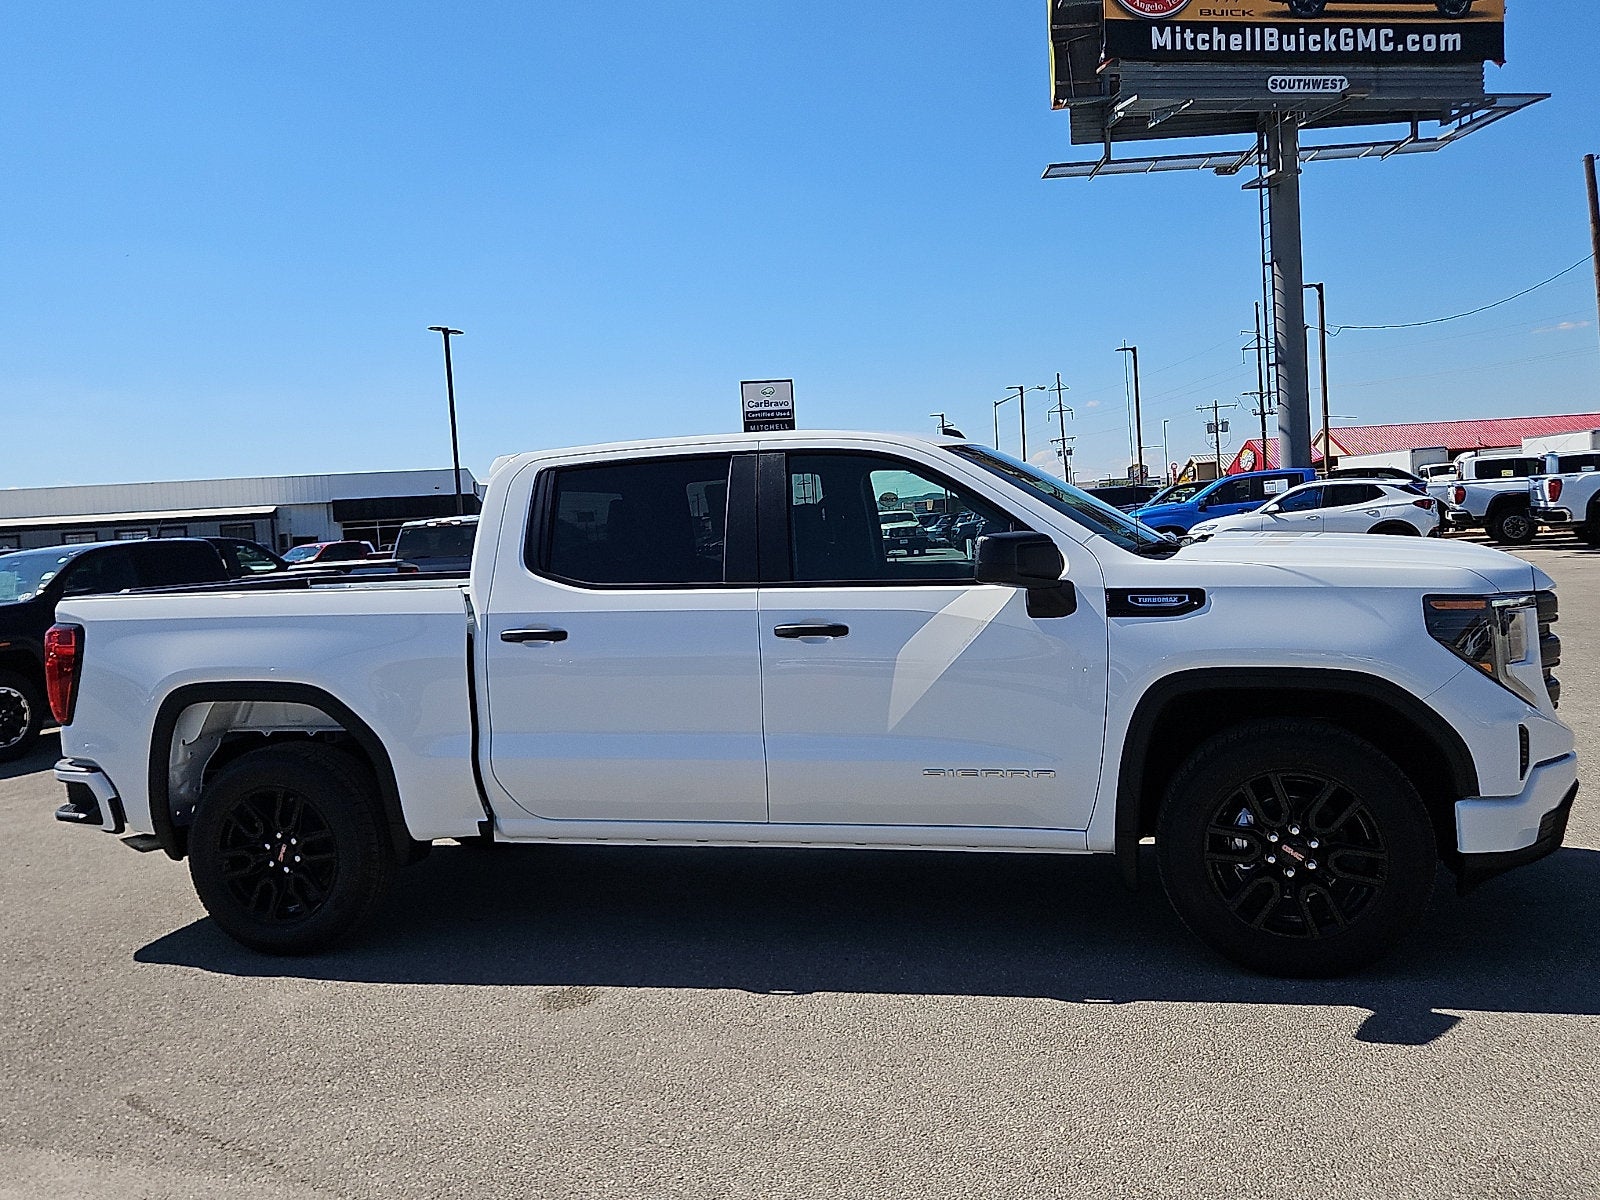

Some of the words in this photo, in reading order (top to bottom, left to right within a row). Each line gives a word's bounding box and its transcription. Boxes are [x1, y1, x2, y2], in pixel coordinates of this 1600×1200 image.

[1199, 8, 1255, 17] BUICK
[1151, 25, 1462, 52] MitchellBuickGMC.com
[1270, 78, 1346, 90] SOUTHWEST
[747, 400, 789, 408] CarBravo
[922, 768, 1057, 778] SIERRA
[1281, 844, 1305, 862] GMC
